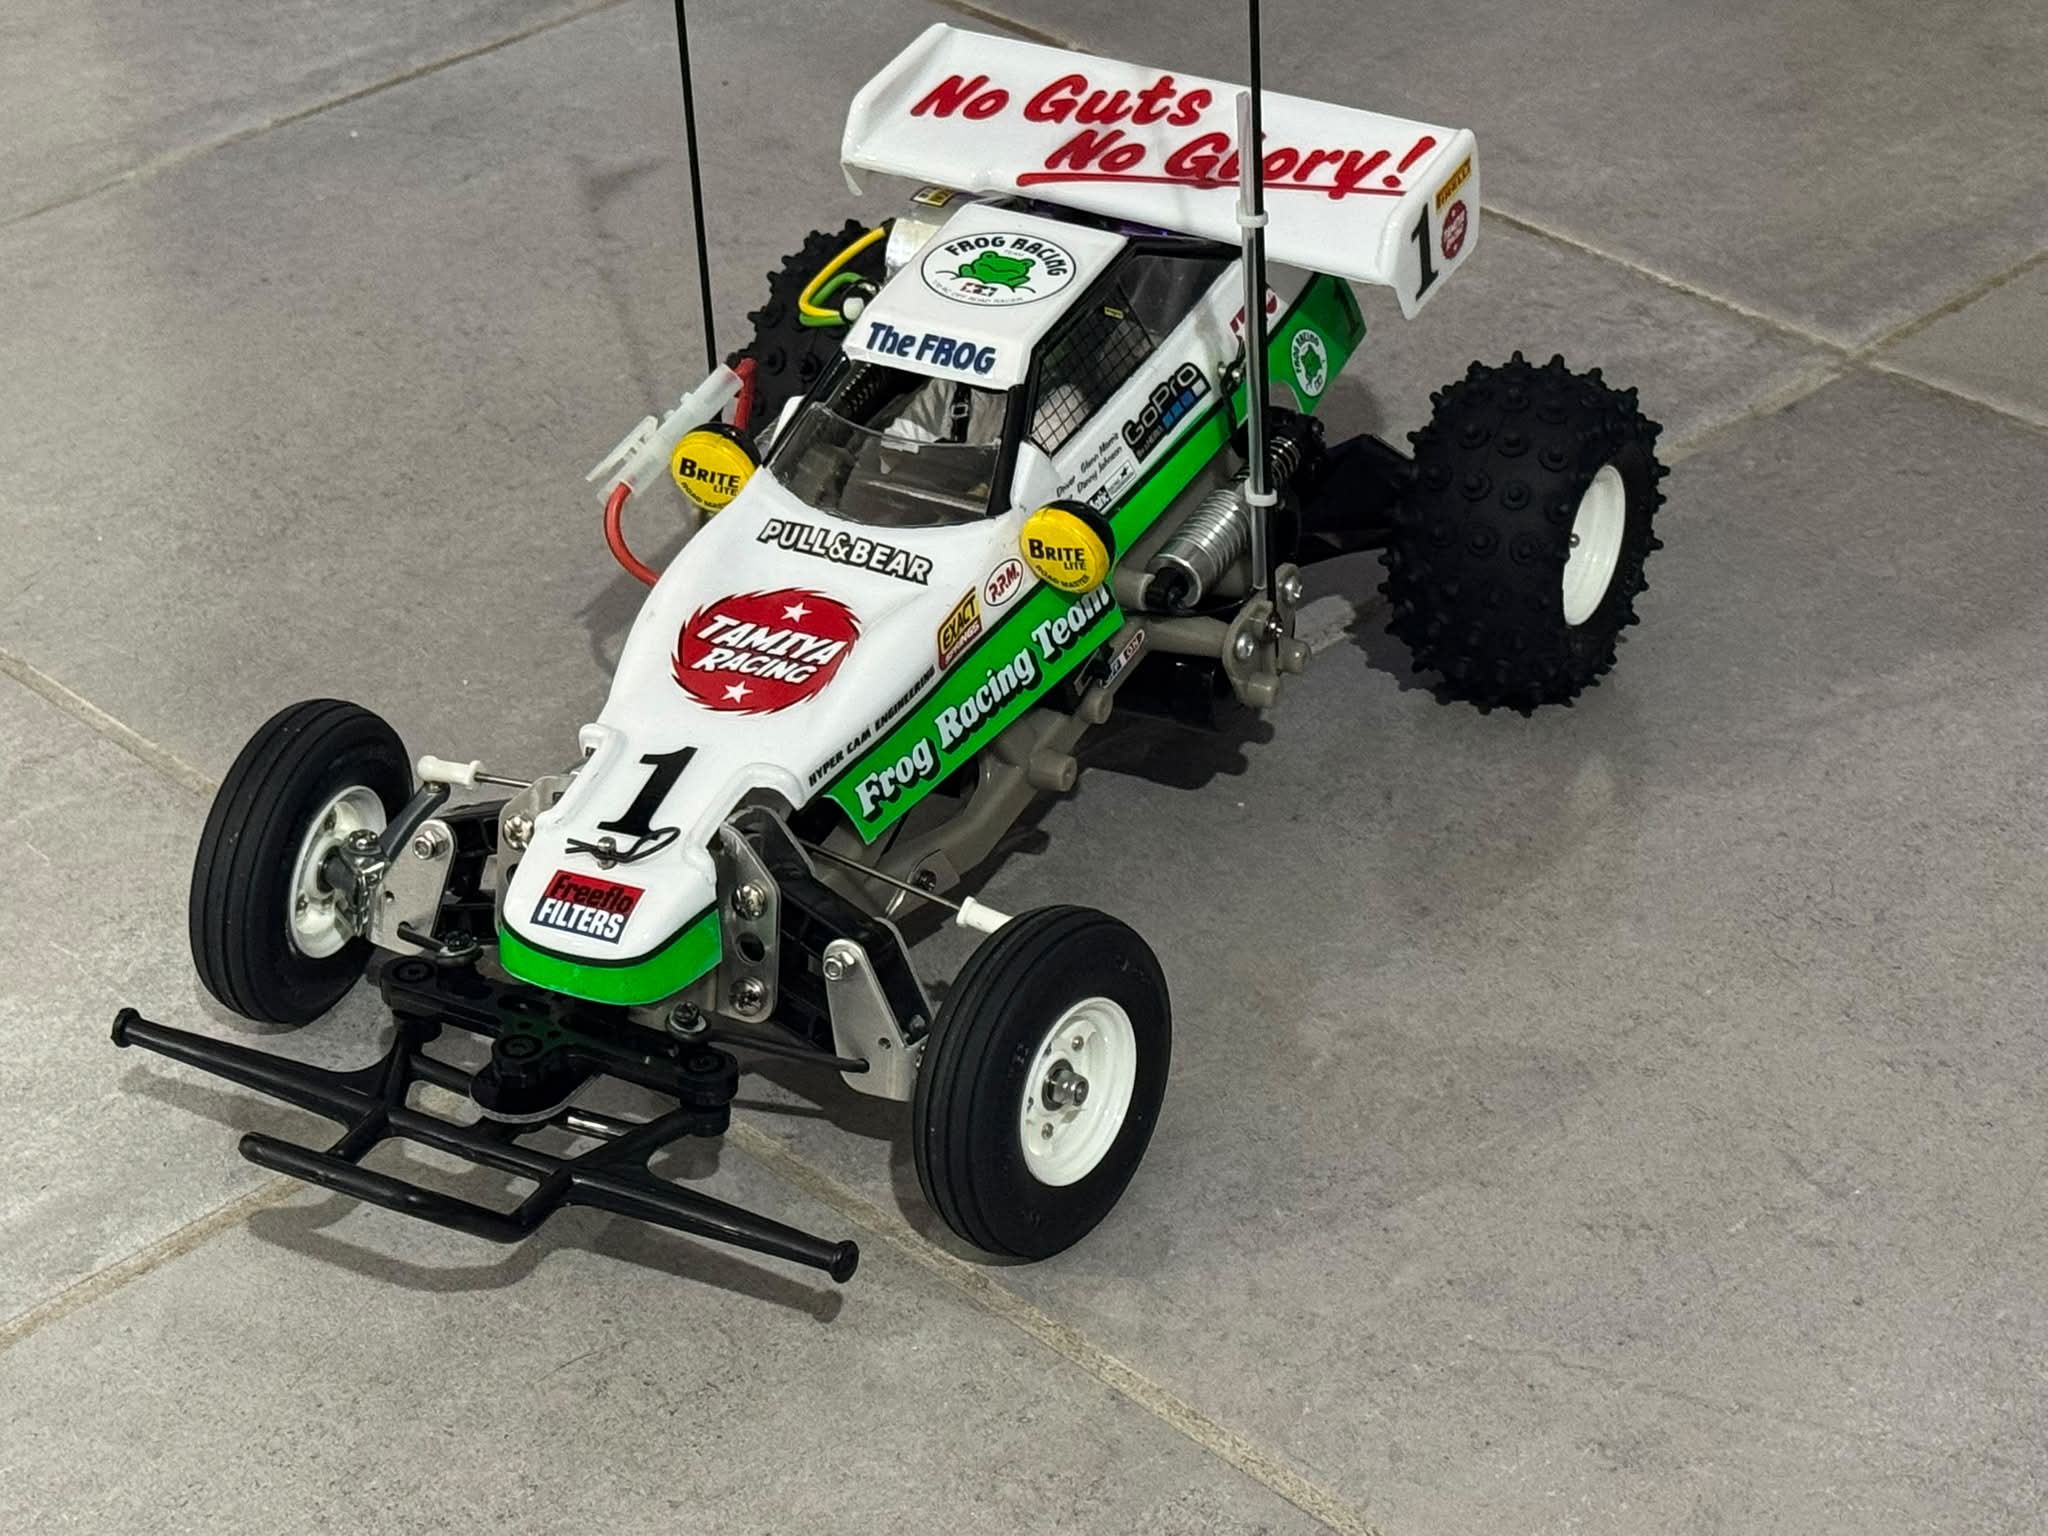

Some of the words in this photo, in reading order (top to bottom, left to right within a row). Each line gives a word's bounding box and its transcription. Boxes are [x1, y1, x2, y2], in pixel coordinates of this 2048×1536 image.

[910, 75, 1010, 120] No
[1023, 74, 1213, 126] Guts
[1044, 129, 1146, 172] No
[944, 236, 1006, 257] FROG
[1009, 238, 1068, 276] RACING
[1411, 202, 1439, 302] 1
[866, 321, 917, 357] The
[915, 333, 997, 375] FROG
[1122, 363, 1199, 446] GoPro
[679, 457, 741, 489] BRITE
[756, 518, 933, 586] PULL&BEAR
[1028, 538, 1085, 562] BRITE
[1063, 560, 1087, 571] LITE
[697, 614, 849, 665] TAMIYA
[942, 594, 976, 651] EXACT
[691, 648, 818, 684] RACING
[808, 750, 845, 787] HYPER
[846, 728, 872, 754] CAM
[874, 664, 936, 732] ENGINEERING
[854, 737, 934, 817] Frog
[934, 648, 1036, 749] Racing
[1031, 584, 1110, 660] Team
[597, 746, 699, 841] 1
[537, 897, 625, 939] FILTERS
[551, 873, 634, 914] Freeflo
